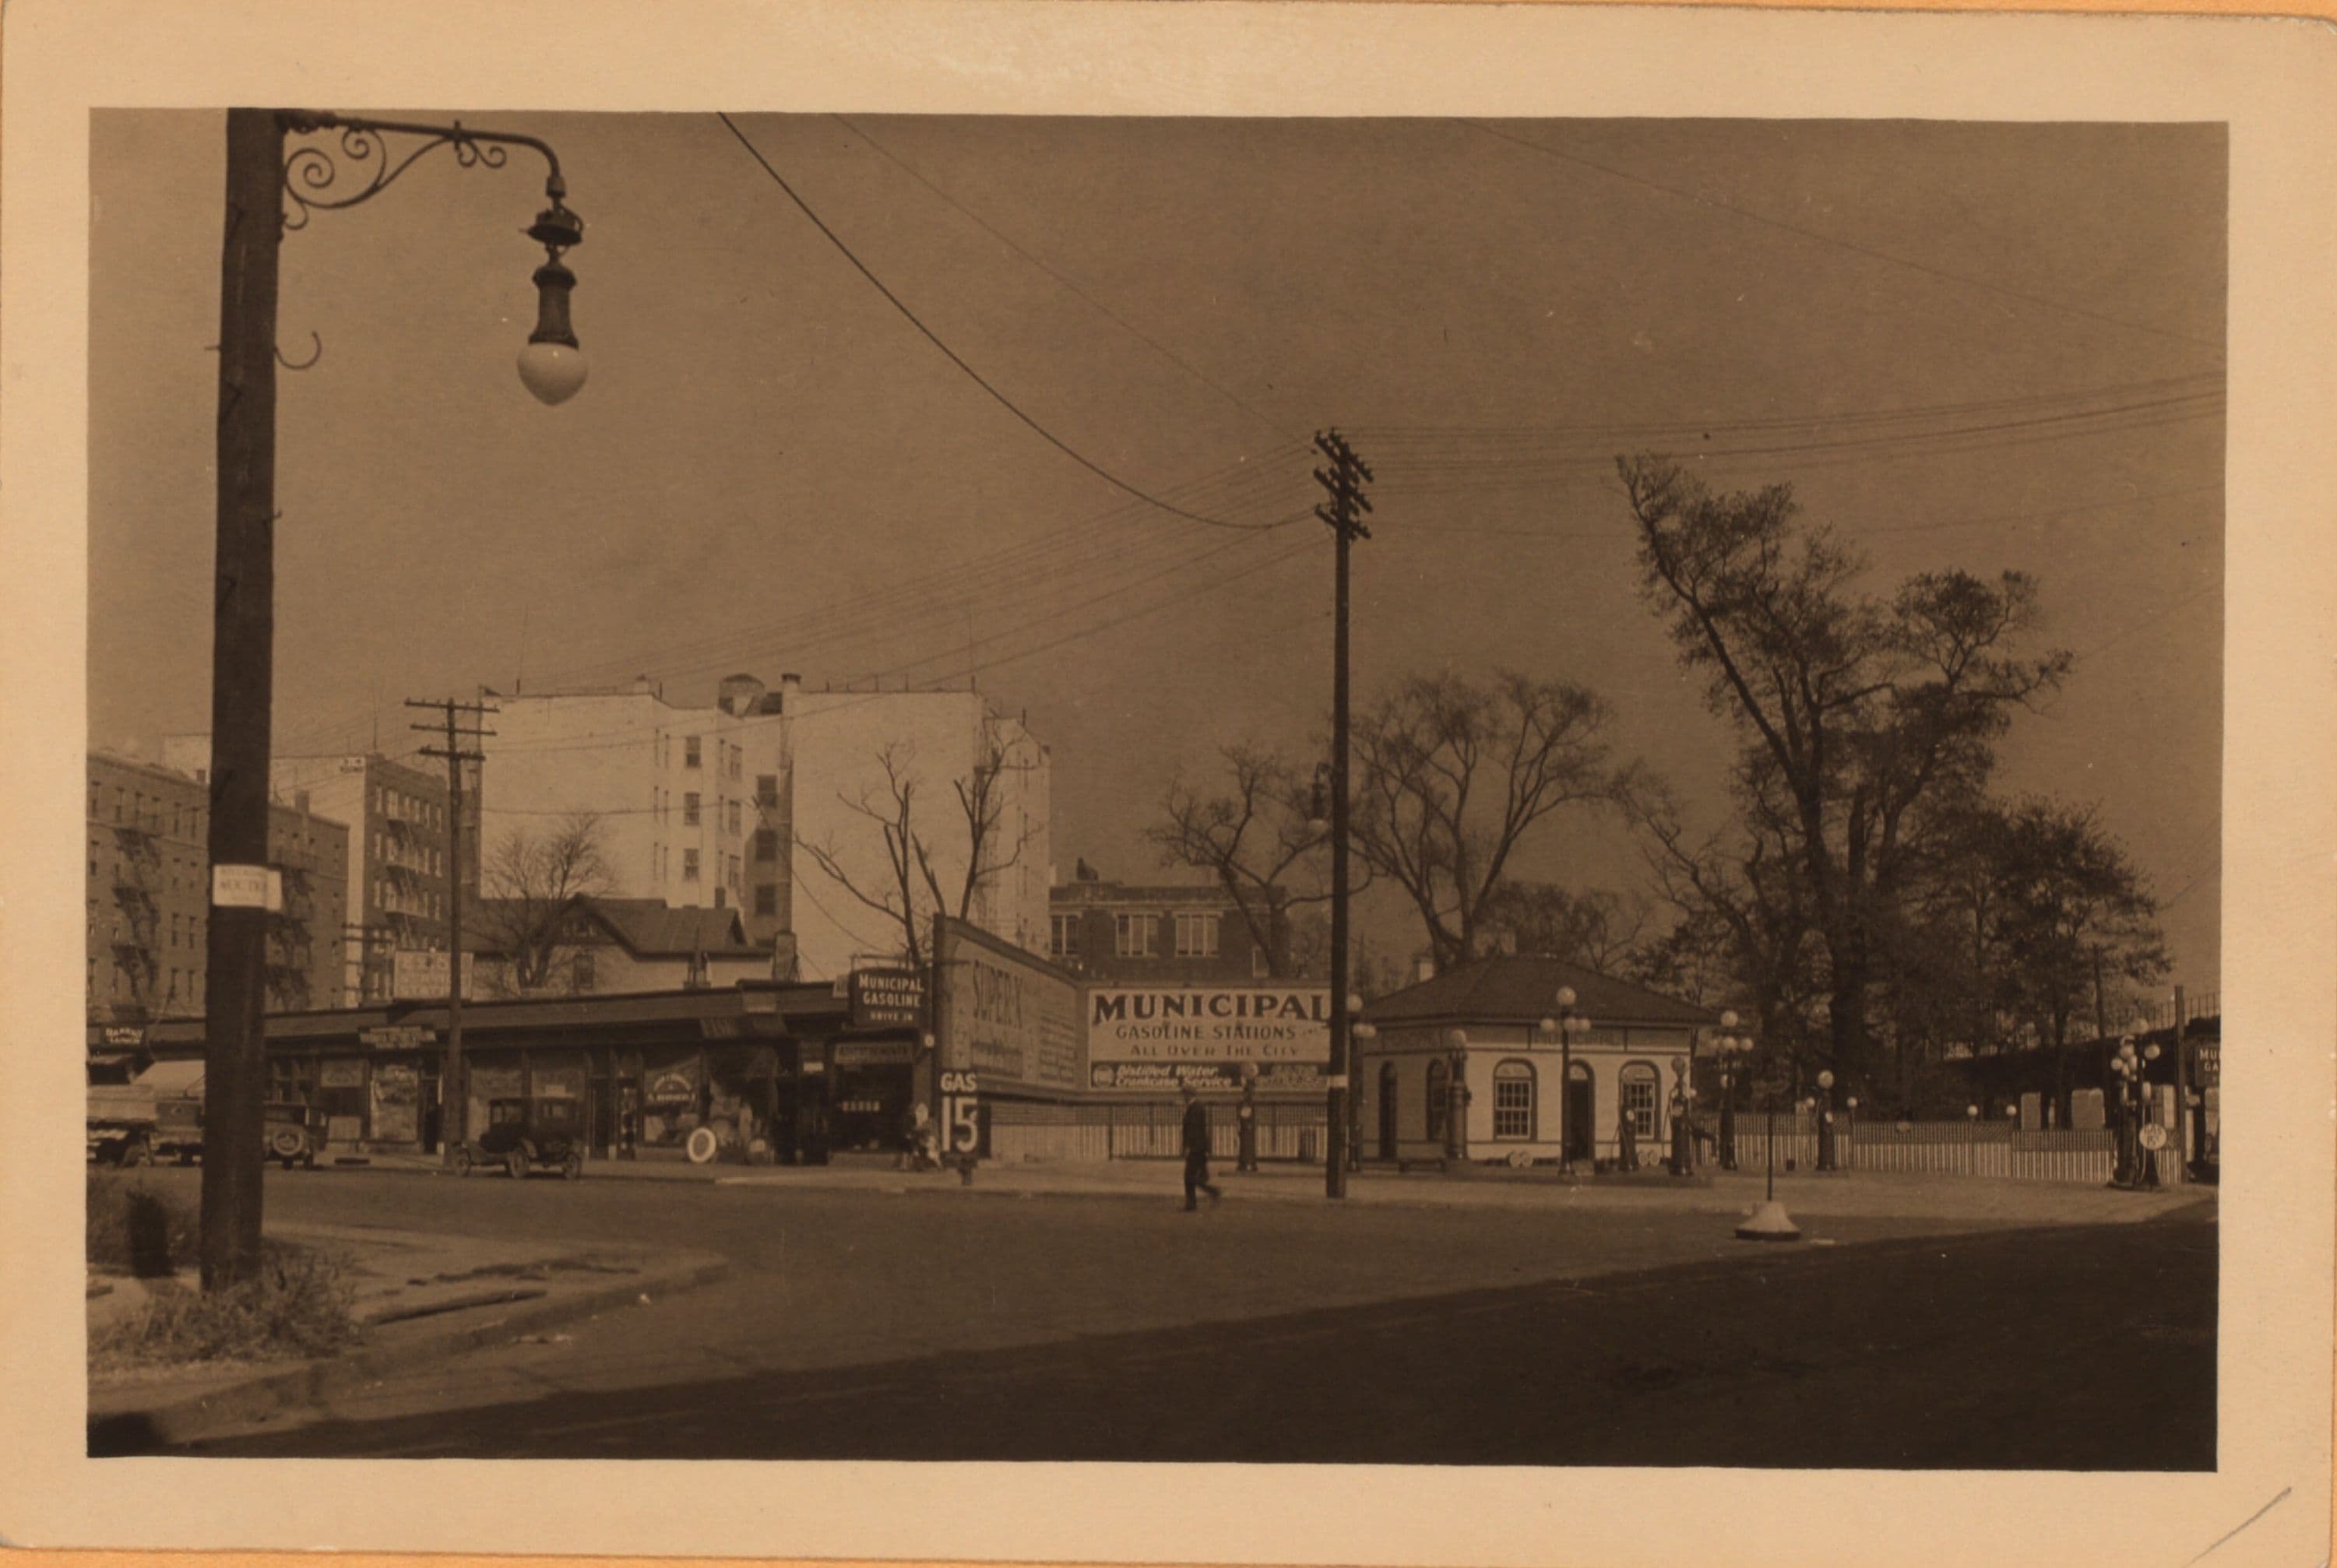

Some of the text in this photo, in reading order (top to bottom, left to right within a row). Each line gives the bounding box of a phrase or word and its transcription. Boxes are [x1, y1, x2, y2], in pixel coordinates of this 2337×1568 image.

[859, 973, 924, 992] MUNICIPAL
[863, 991, 920, 1007] GASOLINE
[1093, 993, 1331, 1025] MUNICIPAL
[1116, 1025, 1295, 1040] GASOLINE STATIONS
[1130, 1044, 1297, 1056] ALL OVER THE CITY
[941, 1072, 977, 1092] GAS
